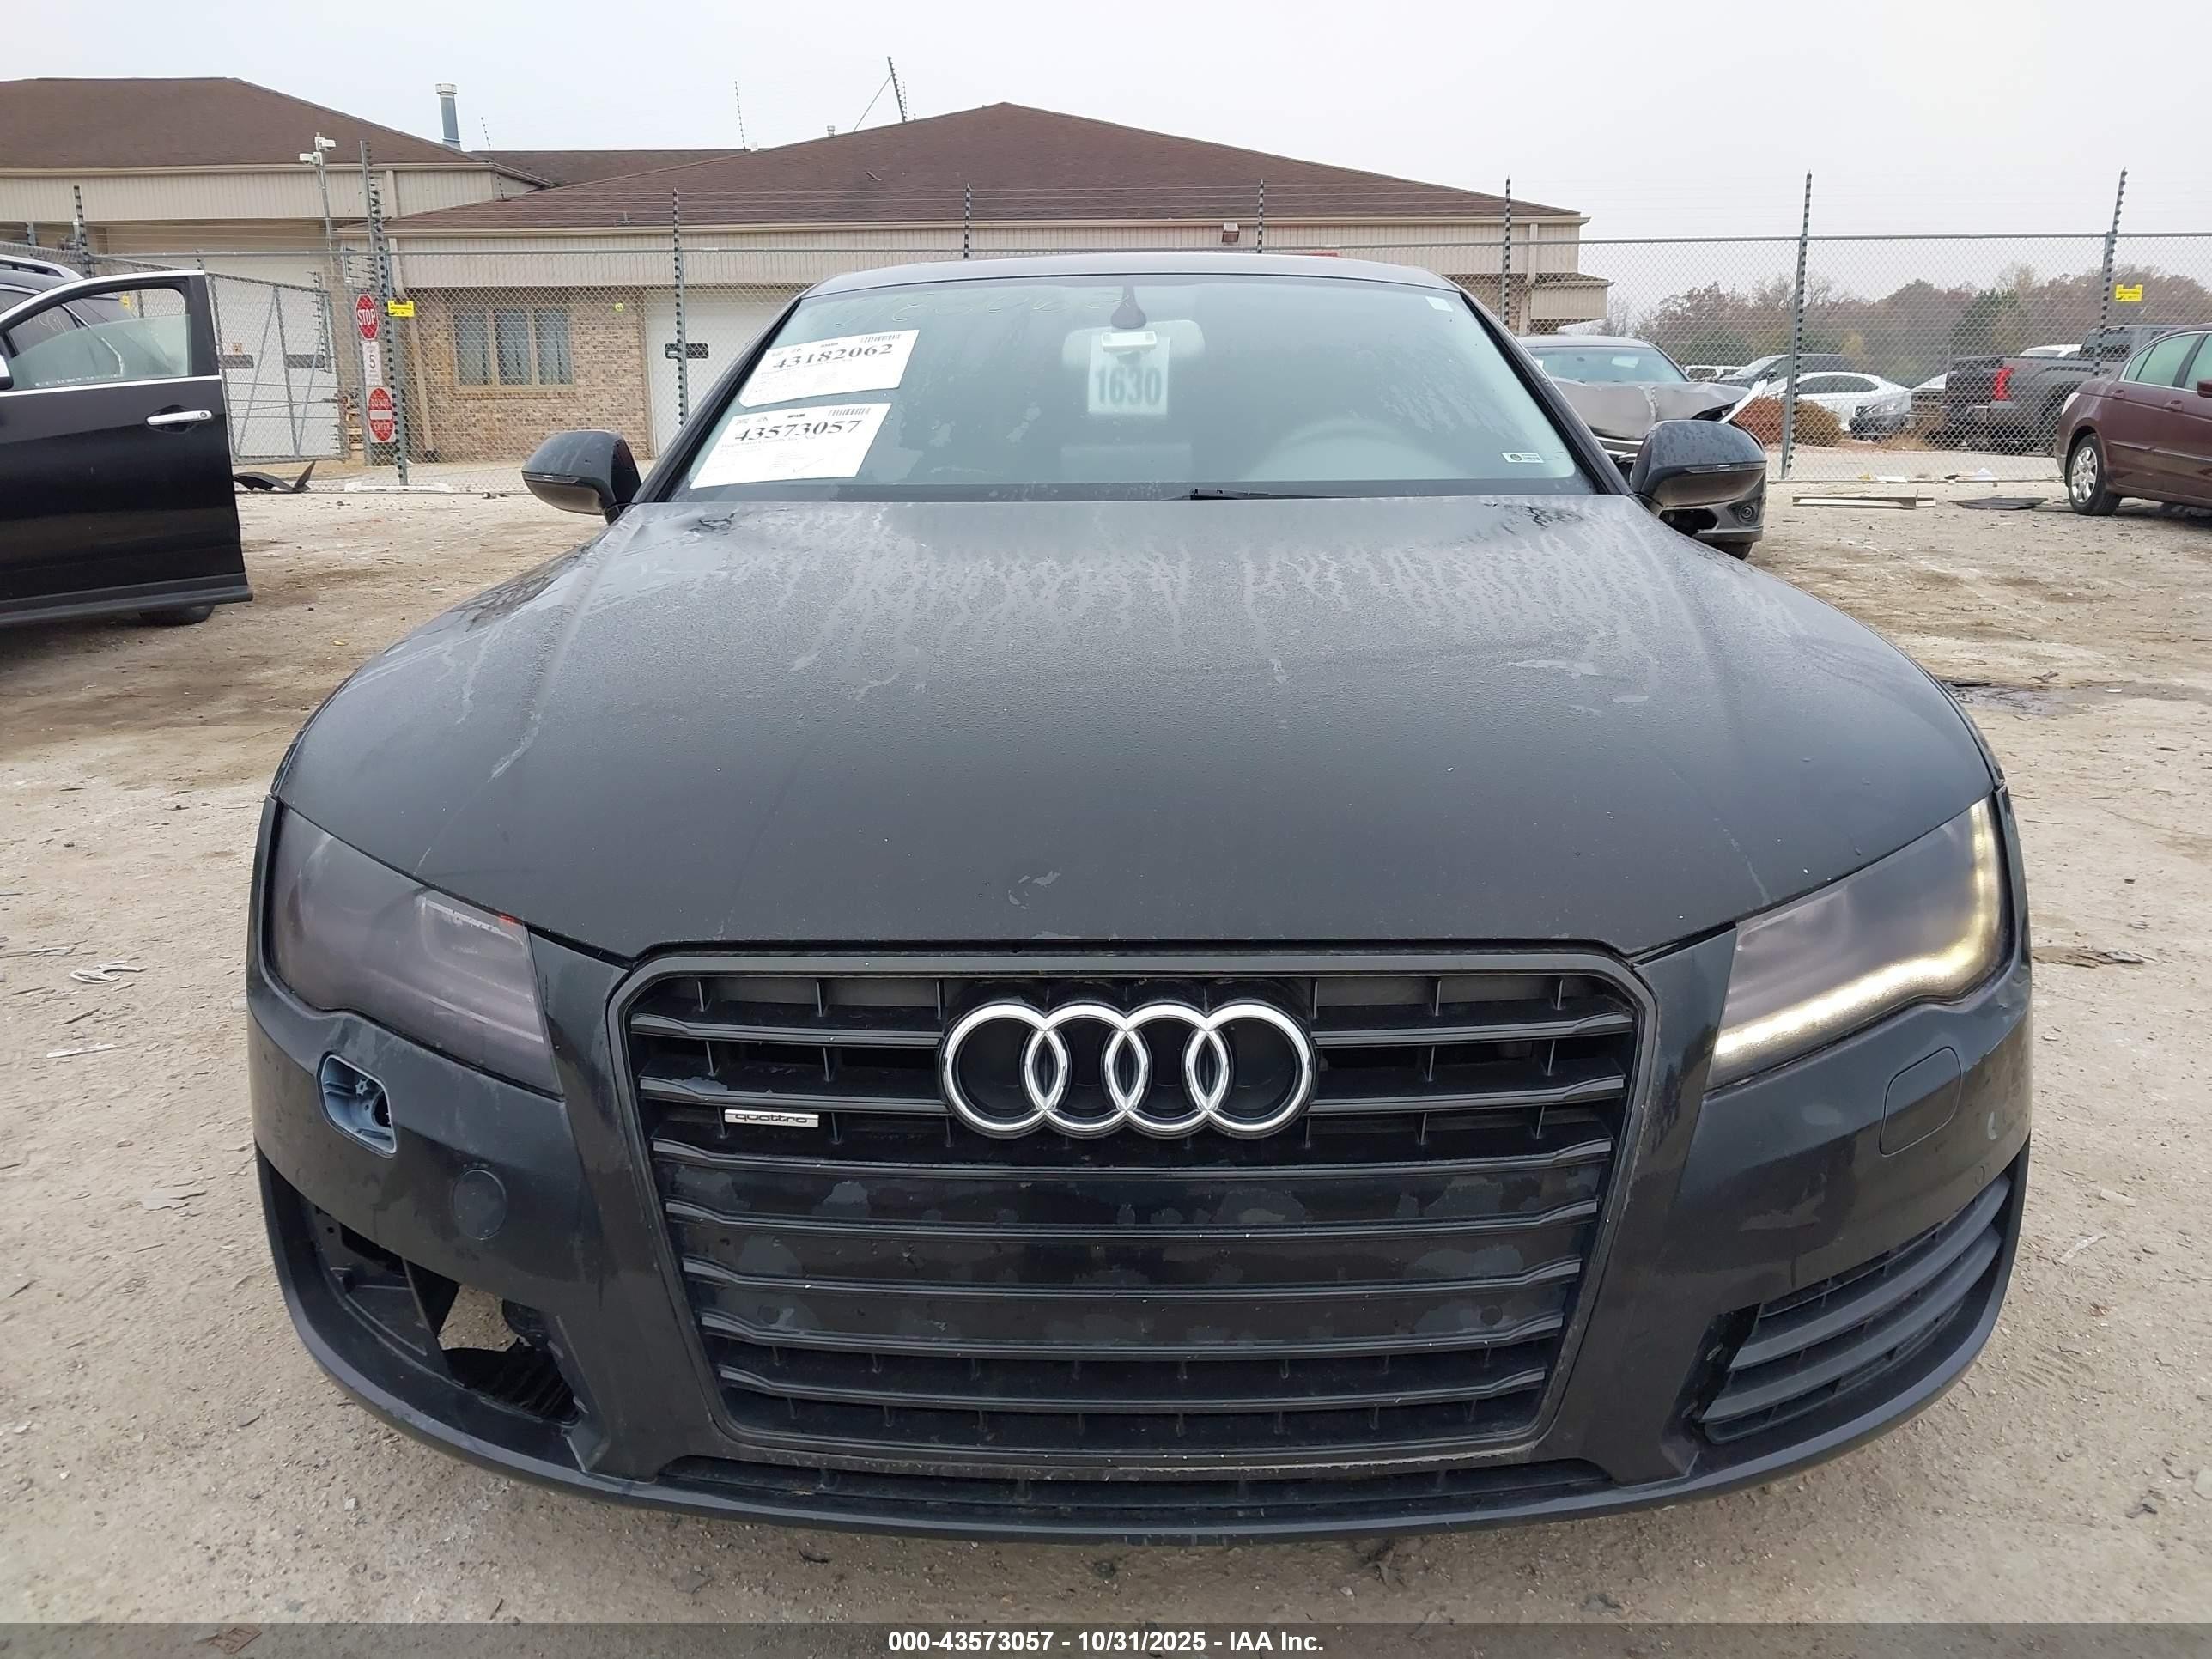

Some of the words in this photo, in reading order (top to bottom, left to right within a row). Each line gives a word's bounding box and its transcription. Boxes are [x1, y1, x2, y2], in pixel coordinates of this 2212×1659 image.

[357, 308, 376, 326] STOP
[368, 354, 377, 369] 5
[772, 343, 894, 369] 43182062
[1094, 366, 1163, 406] 1630
[734, 420, 864, 442] 43573057
[734, 1113, 808, 1123] quattro
